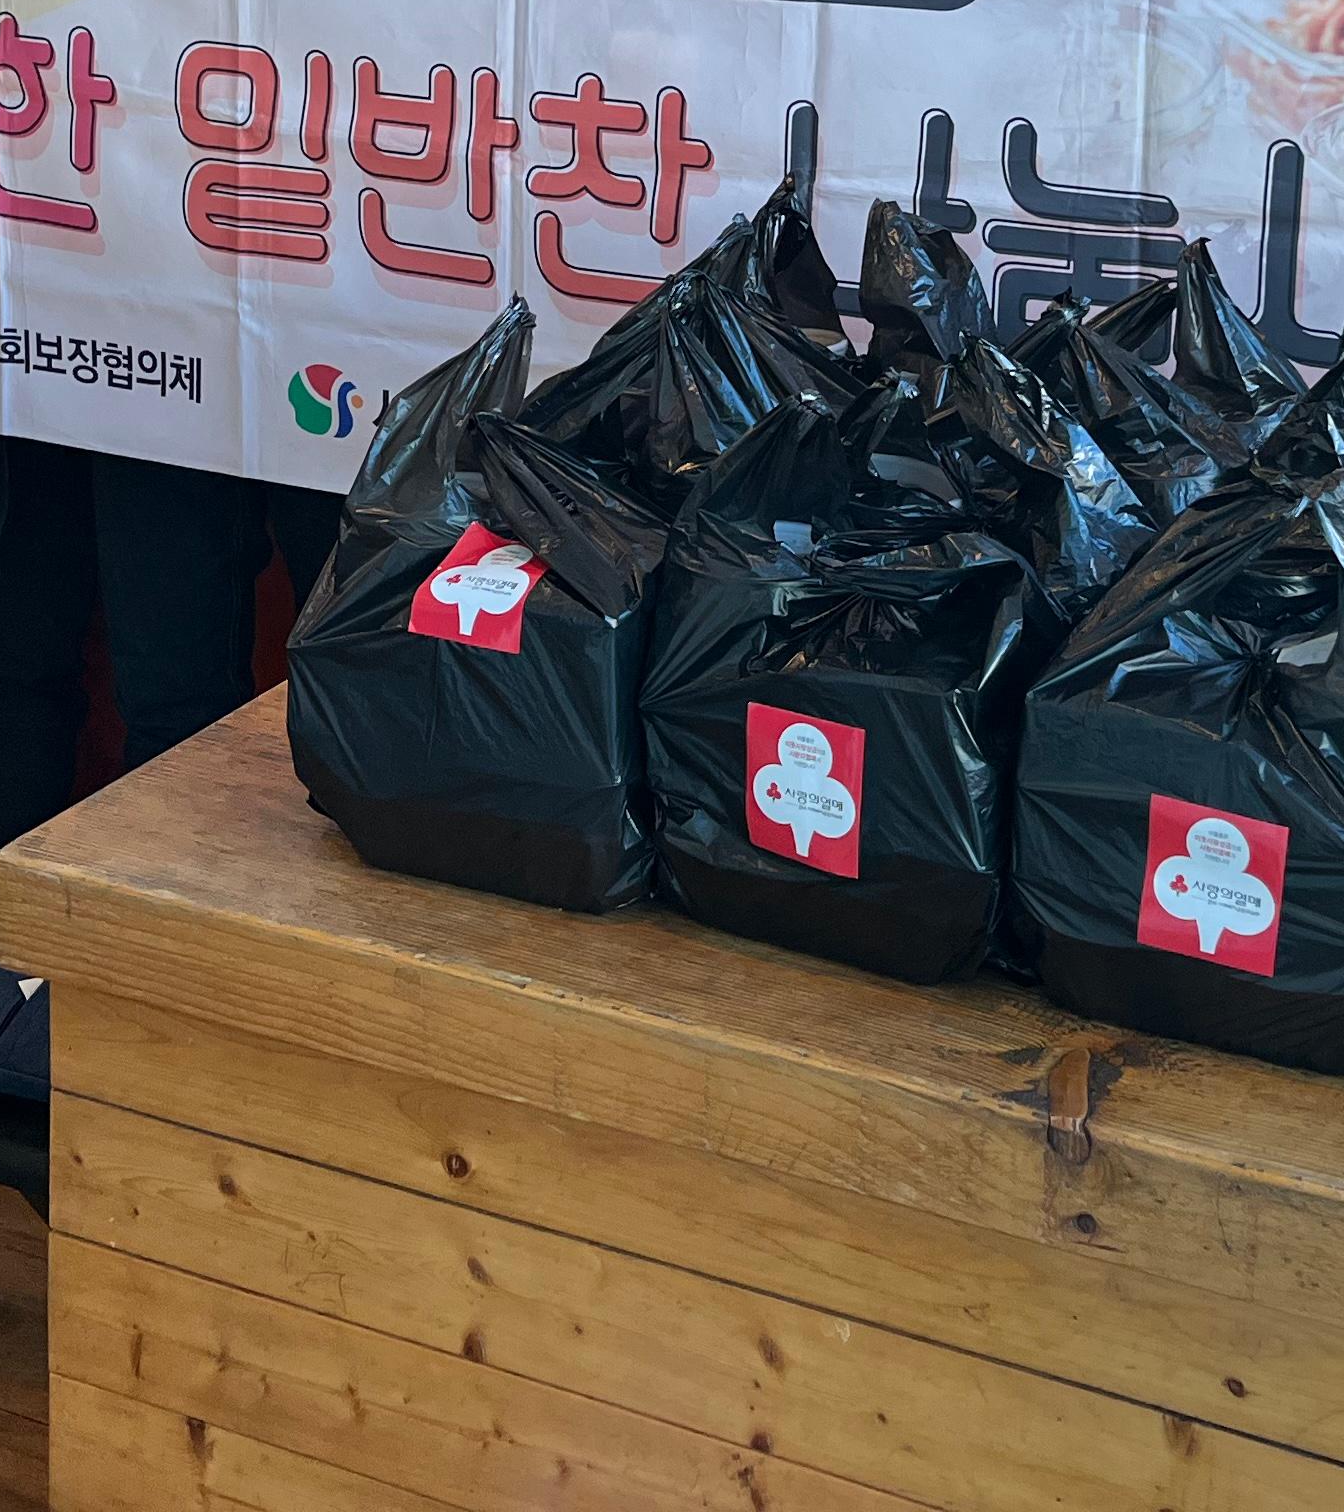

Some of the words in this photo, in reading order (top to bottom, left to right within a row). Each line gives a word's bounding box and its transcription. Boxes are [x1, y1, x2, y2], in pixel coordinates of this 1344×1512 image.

[173, 39, 713, 303] 밑반찬
[784, 787, 844, 812] 사랑의열매
[1192, 880, 1262, 908] 사랑의열매
